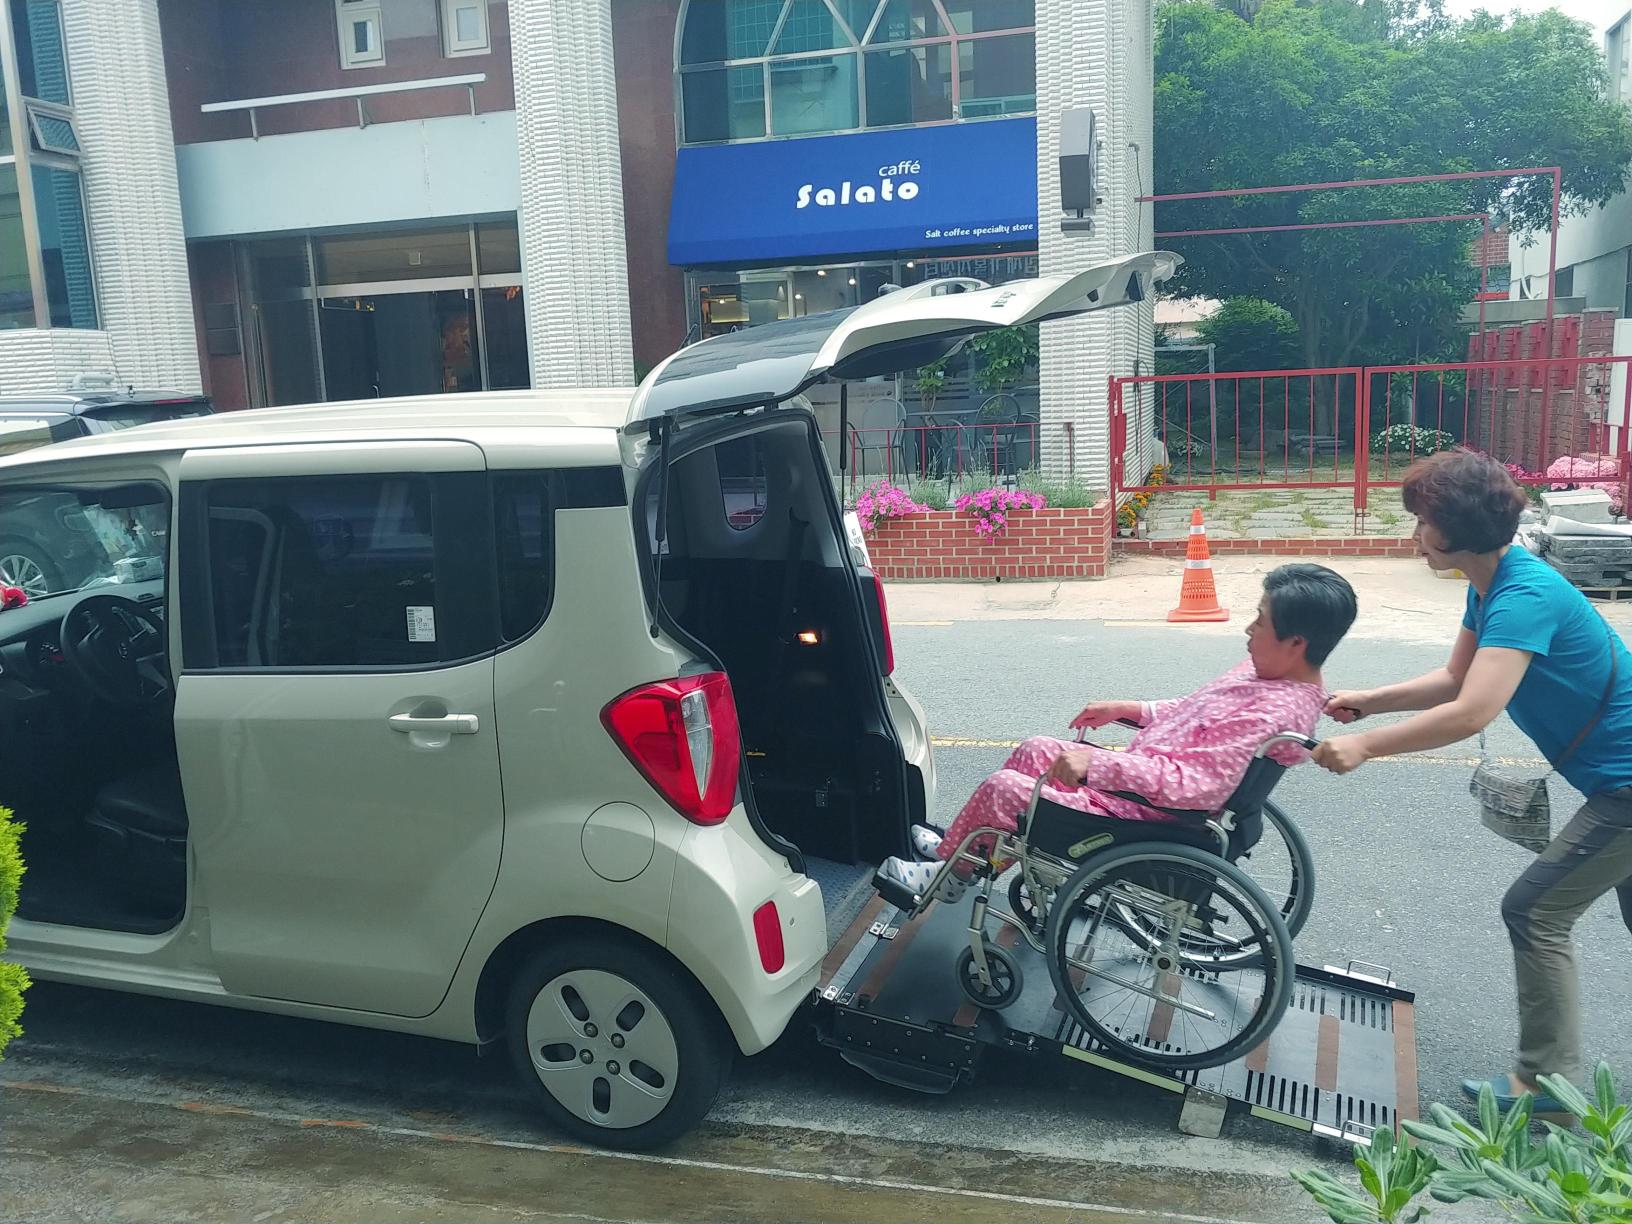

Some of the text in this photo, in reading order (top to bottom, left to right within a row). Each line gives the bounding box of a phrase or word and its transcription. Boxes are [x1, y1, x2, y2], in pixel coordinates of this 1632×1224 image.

[878, 159, 920, 177] caffé
[796, 178, 919, 209] Salato
[925, 223, 1034, 239] Salt coffee specialty store
